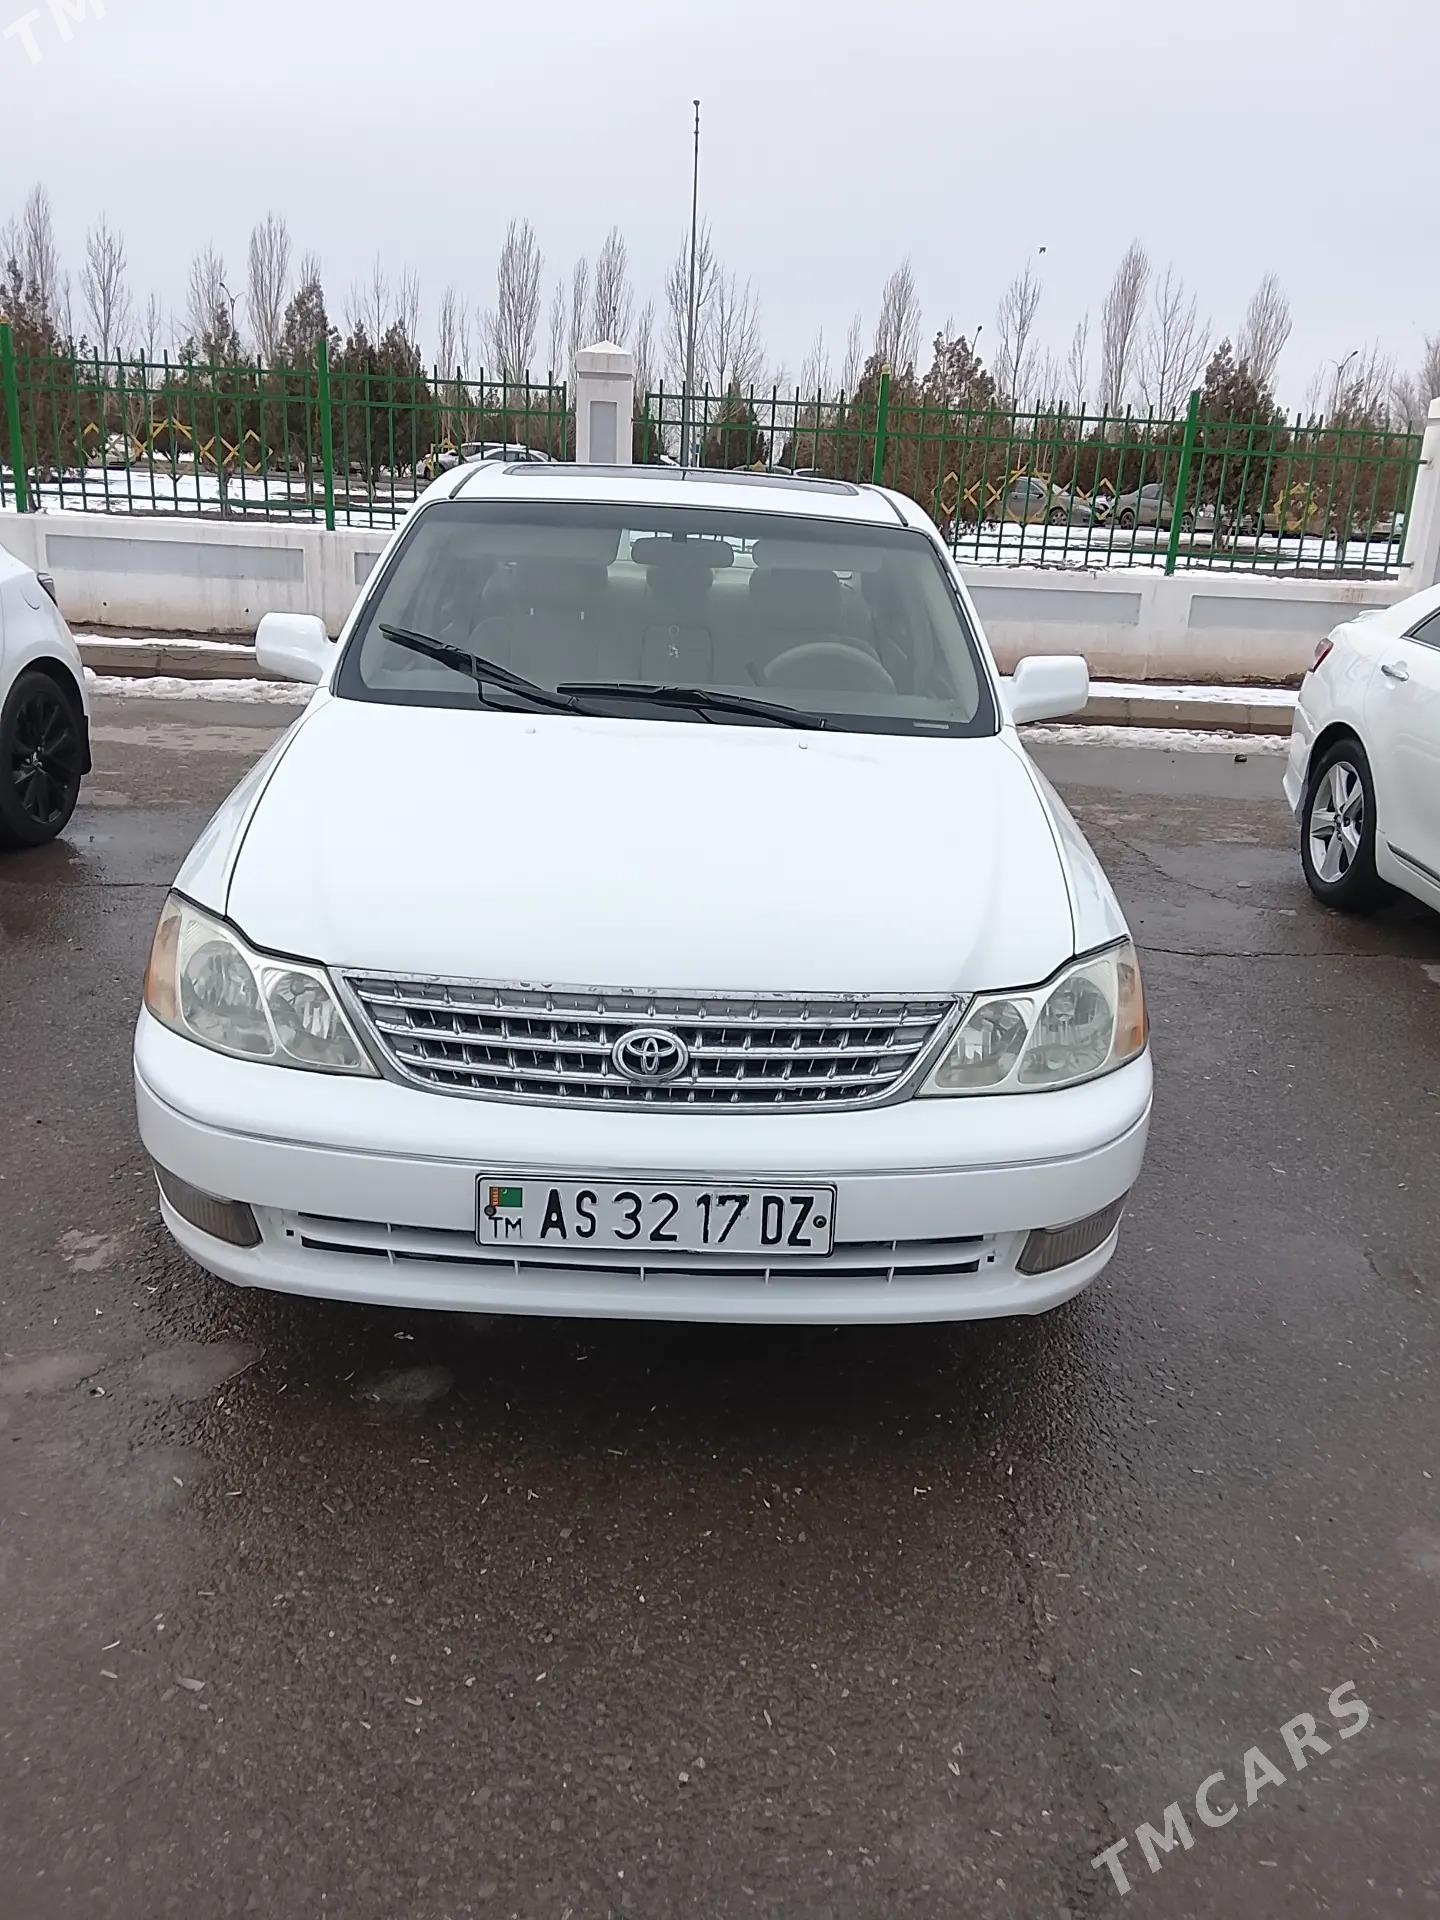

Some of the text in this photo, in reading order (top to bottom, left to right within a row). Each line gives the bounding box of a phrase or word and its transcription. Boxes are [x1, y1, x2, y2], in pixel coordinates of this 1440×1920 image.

[488, 1216, 523, 1239] TM
[540, 1189, 598, 1240] AS
[760, 1195, 815, 1247] DZ
